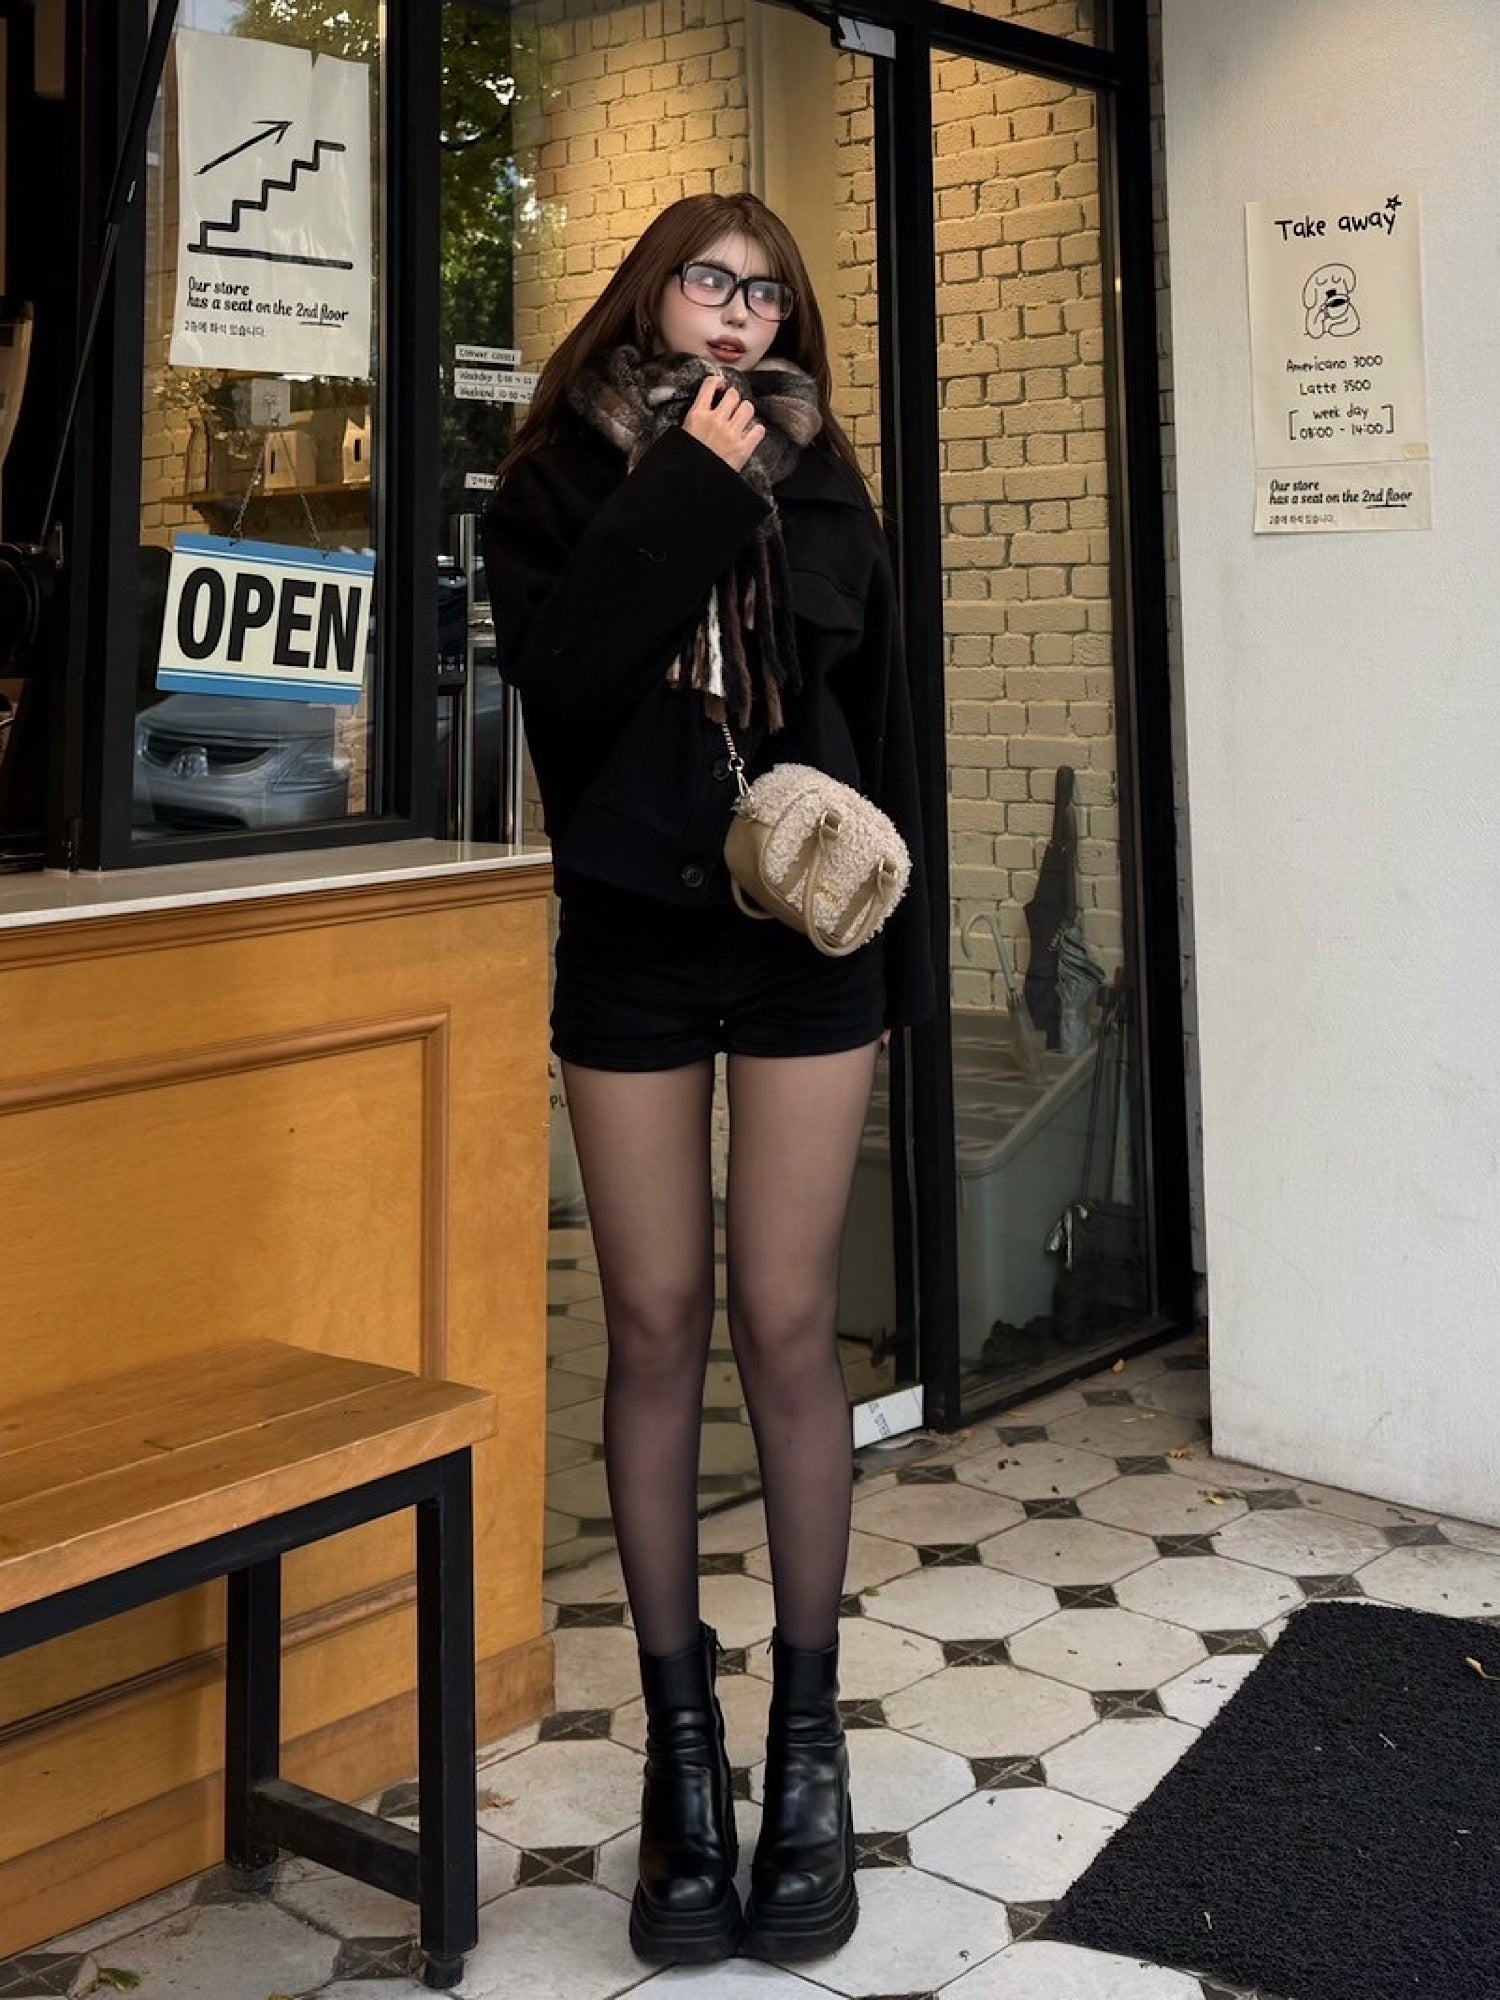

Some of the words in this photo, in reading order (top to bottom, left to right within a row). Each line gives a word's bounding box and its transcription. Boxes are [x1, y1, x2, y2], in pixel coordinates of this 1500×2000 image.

[1274, 215, 1326, 240] Take
[1338, 211, 1396, 235] away
[188, 276, 211, 293] Our
[213, 281, 250, 296] store
[187, 292, 208, 309] has
[212, 300, 222, 310] a
[224, 299, 253, 313] seat
[255, 302, 272, 314] on
[273, 299, 293, 317] the
[296, 303, 319, 318] 2nd
[319, 303, 349, 325] floor
[1286, 355, 1348, 372] Americano
[1353, 355, 1383, 368] 3000
[1299, 382, 1337, 396] Latte
[1342, 379, 1372, 393] 3500
[1312, 405, 1341, 420] week
[1346, 402, 1369, 420] day
[1269, 478, 1291, 492] Our
[1292, 480, 1319, 492] store
[1269, 492, 1289, 505] has
[1290, 495, 1298, 504] a
[1300, 492, 1323, 504] seat
[1325, 494, 1340, 503] on
[1342, 489, 1359, 503] the
[1361, 488, 1384, 503] 2nd
[1384, 487, 1413, 507] floor
[177, 566, 362, 672] OPEN
